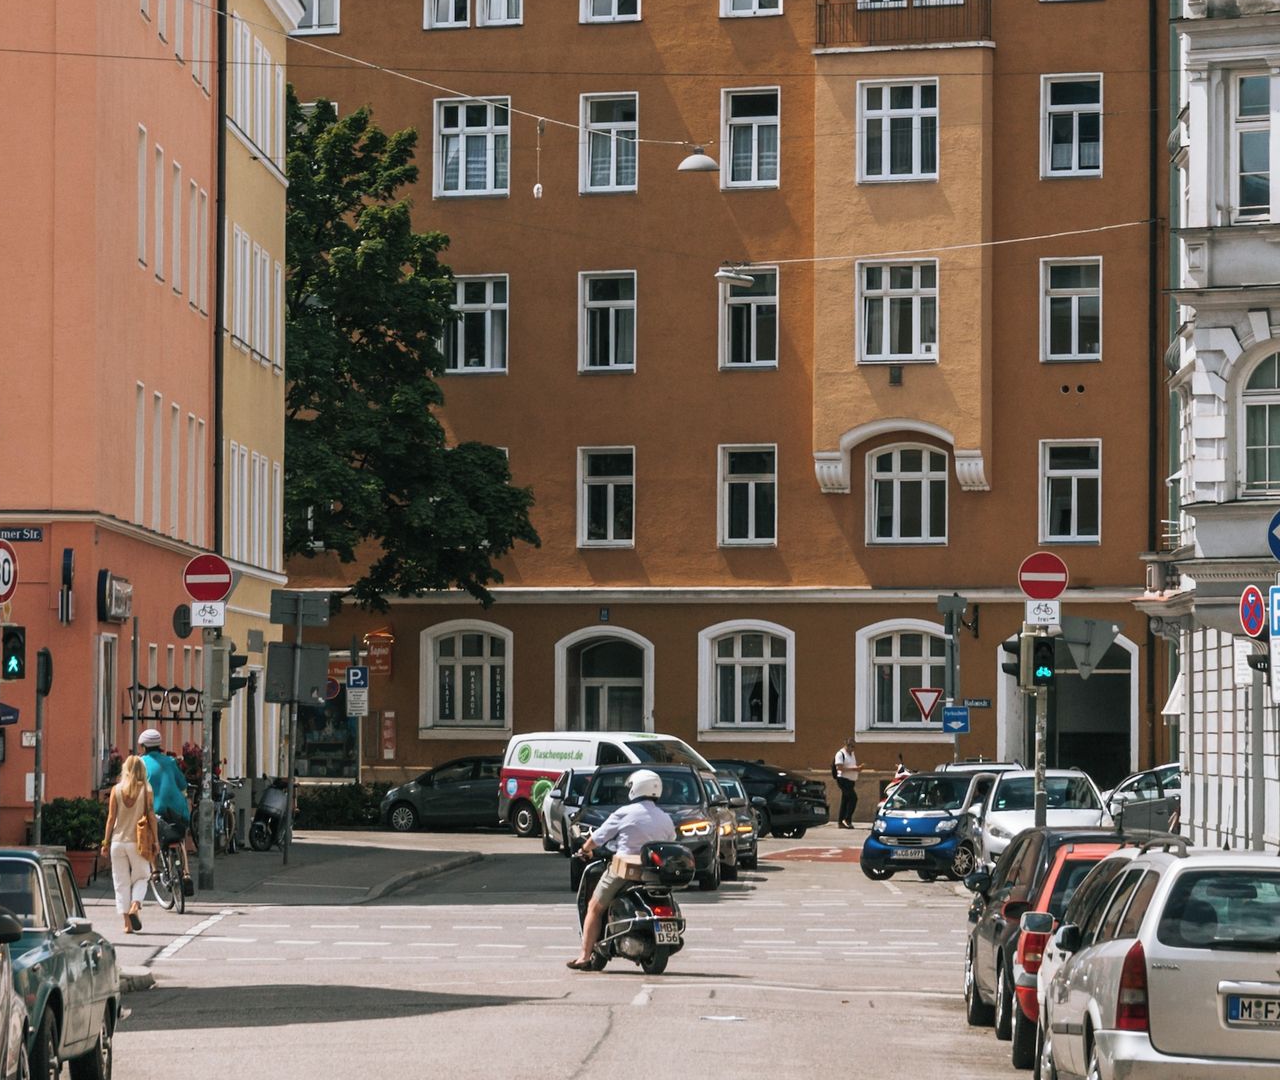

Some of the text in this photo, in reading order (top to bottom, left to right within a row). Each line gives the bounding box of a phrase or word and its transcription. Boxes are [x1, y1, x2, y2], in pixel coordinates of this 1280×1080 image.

[23, 528, 40, 539] Str.
[349, 669, 362, 686] P
[534, 748, 584, 761] flaschenpost.de
[658, 933, 678, 942] D 56
[1240, 1000, 1252, 1018] M
